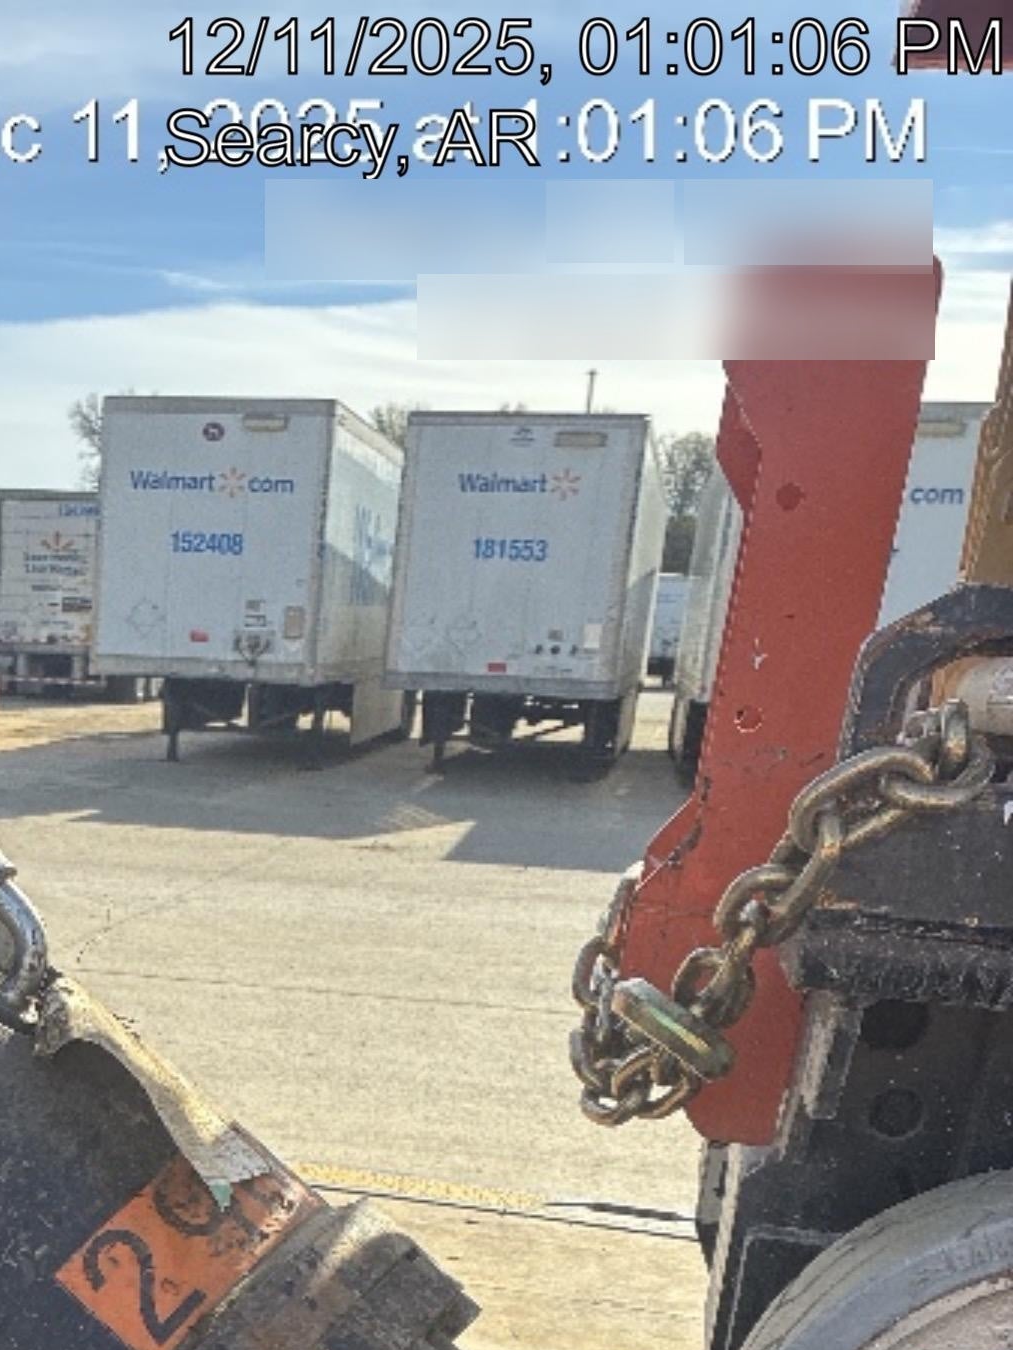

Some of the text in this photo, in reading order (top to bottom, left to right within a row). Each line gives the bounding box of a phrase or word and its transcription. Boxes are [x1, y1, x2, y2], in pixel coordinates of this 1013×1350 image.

[130, 469, 216, 493] Walmart
[458, 472, 549, 494] Walmart
[170, 530, 244, 556] 152408
[472, 537, 550, 562] 181553
